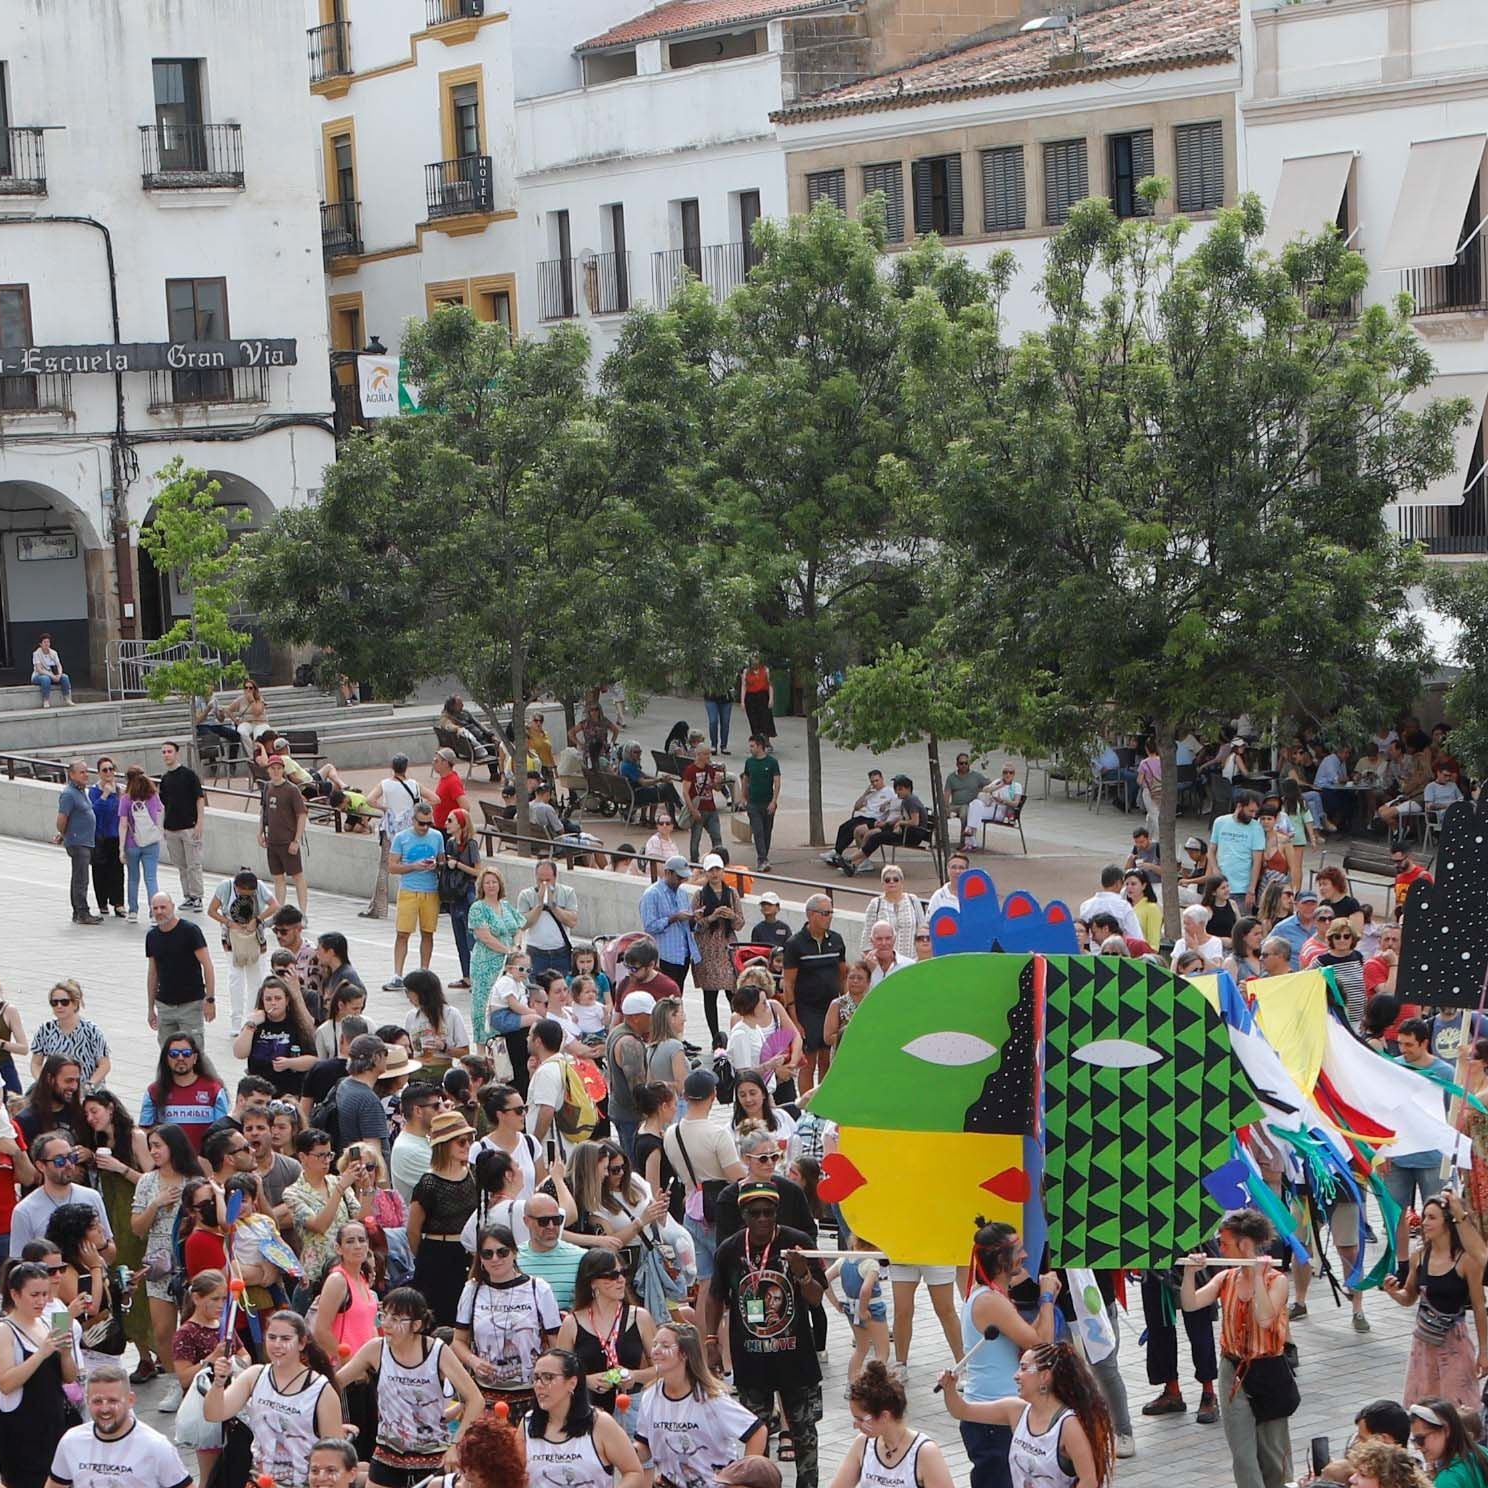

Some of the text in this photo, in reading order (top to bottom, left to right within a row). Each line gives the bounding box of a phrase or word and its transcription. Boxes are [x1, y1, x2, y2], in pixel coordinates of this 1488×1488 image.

[479, 158, 487, 206] HOTEL
[167, 344, 225, 368] Gran
[78, 1462, 134, 1474] EXTRETUCADA
